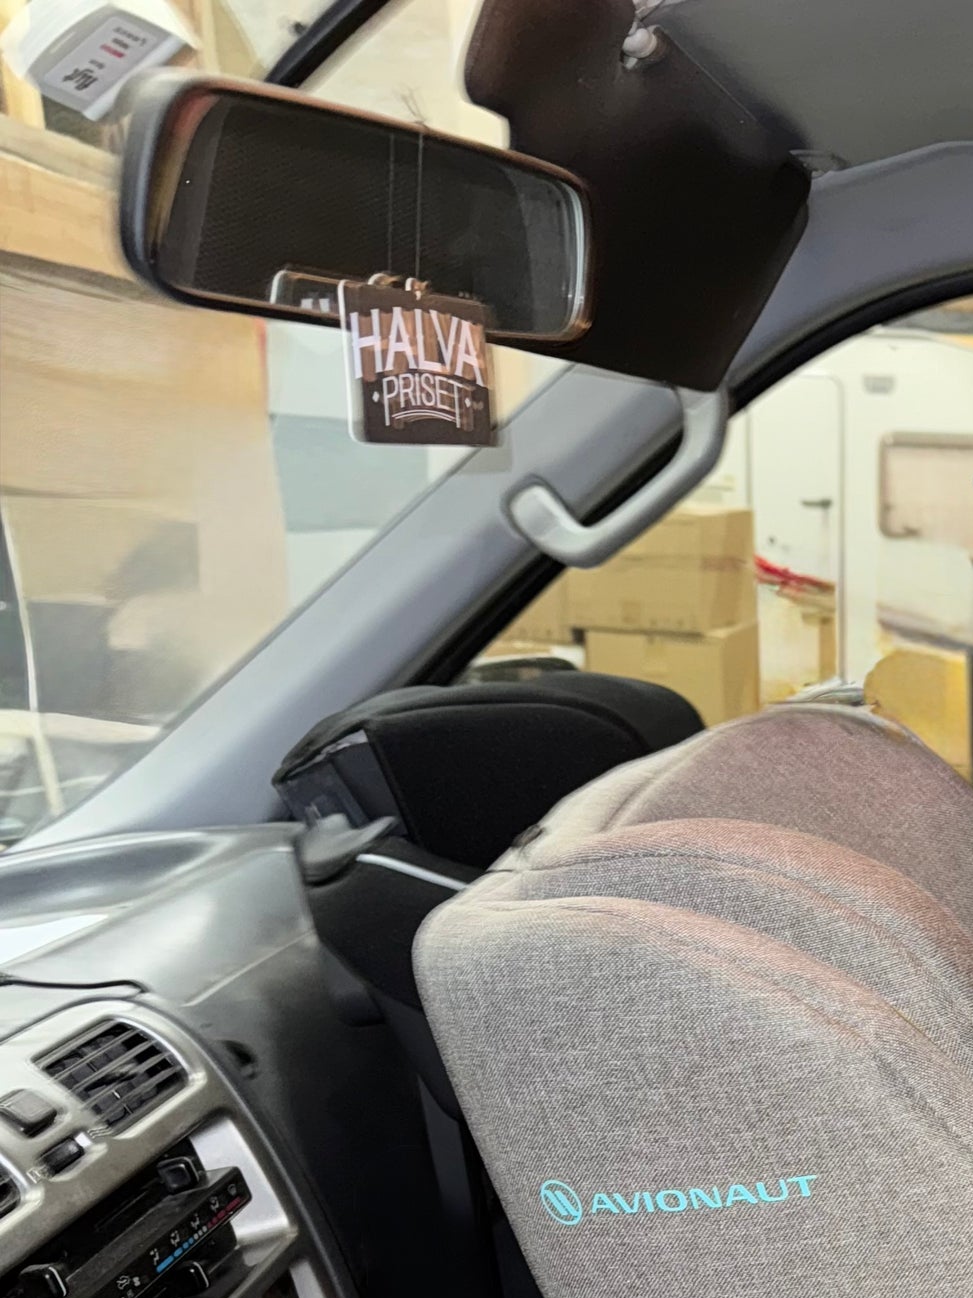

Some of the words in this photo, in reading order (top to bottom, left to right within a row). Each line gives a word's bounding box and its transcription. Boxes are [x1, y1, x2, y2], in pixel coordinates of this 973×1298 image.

[350, 306, 485, 387] HALVA
[383, 373, 468, 428] PRISET
[591, 1175, 817, 1214] AVIONAUT
